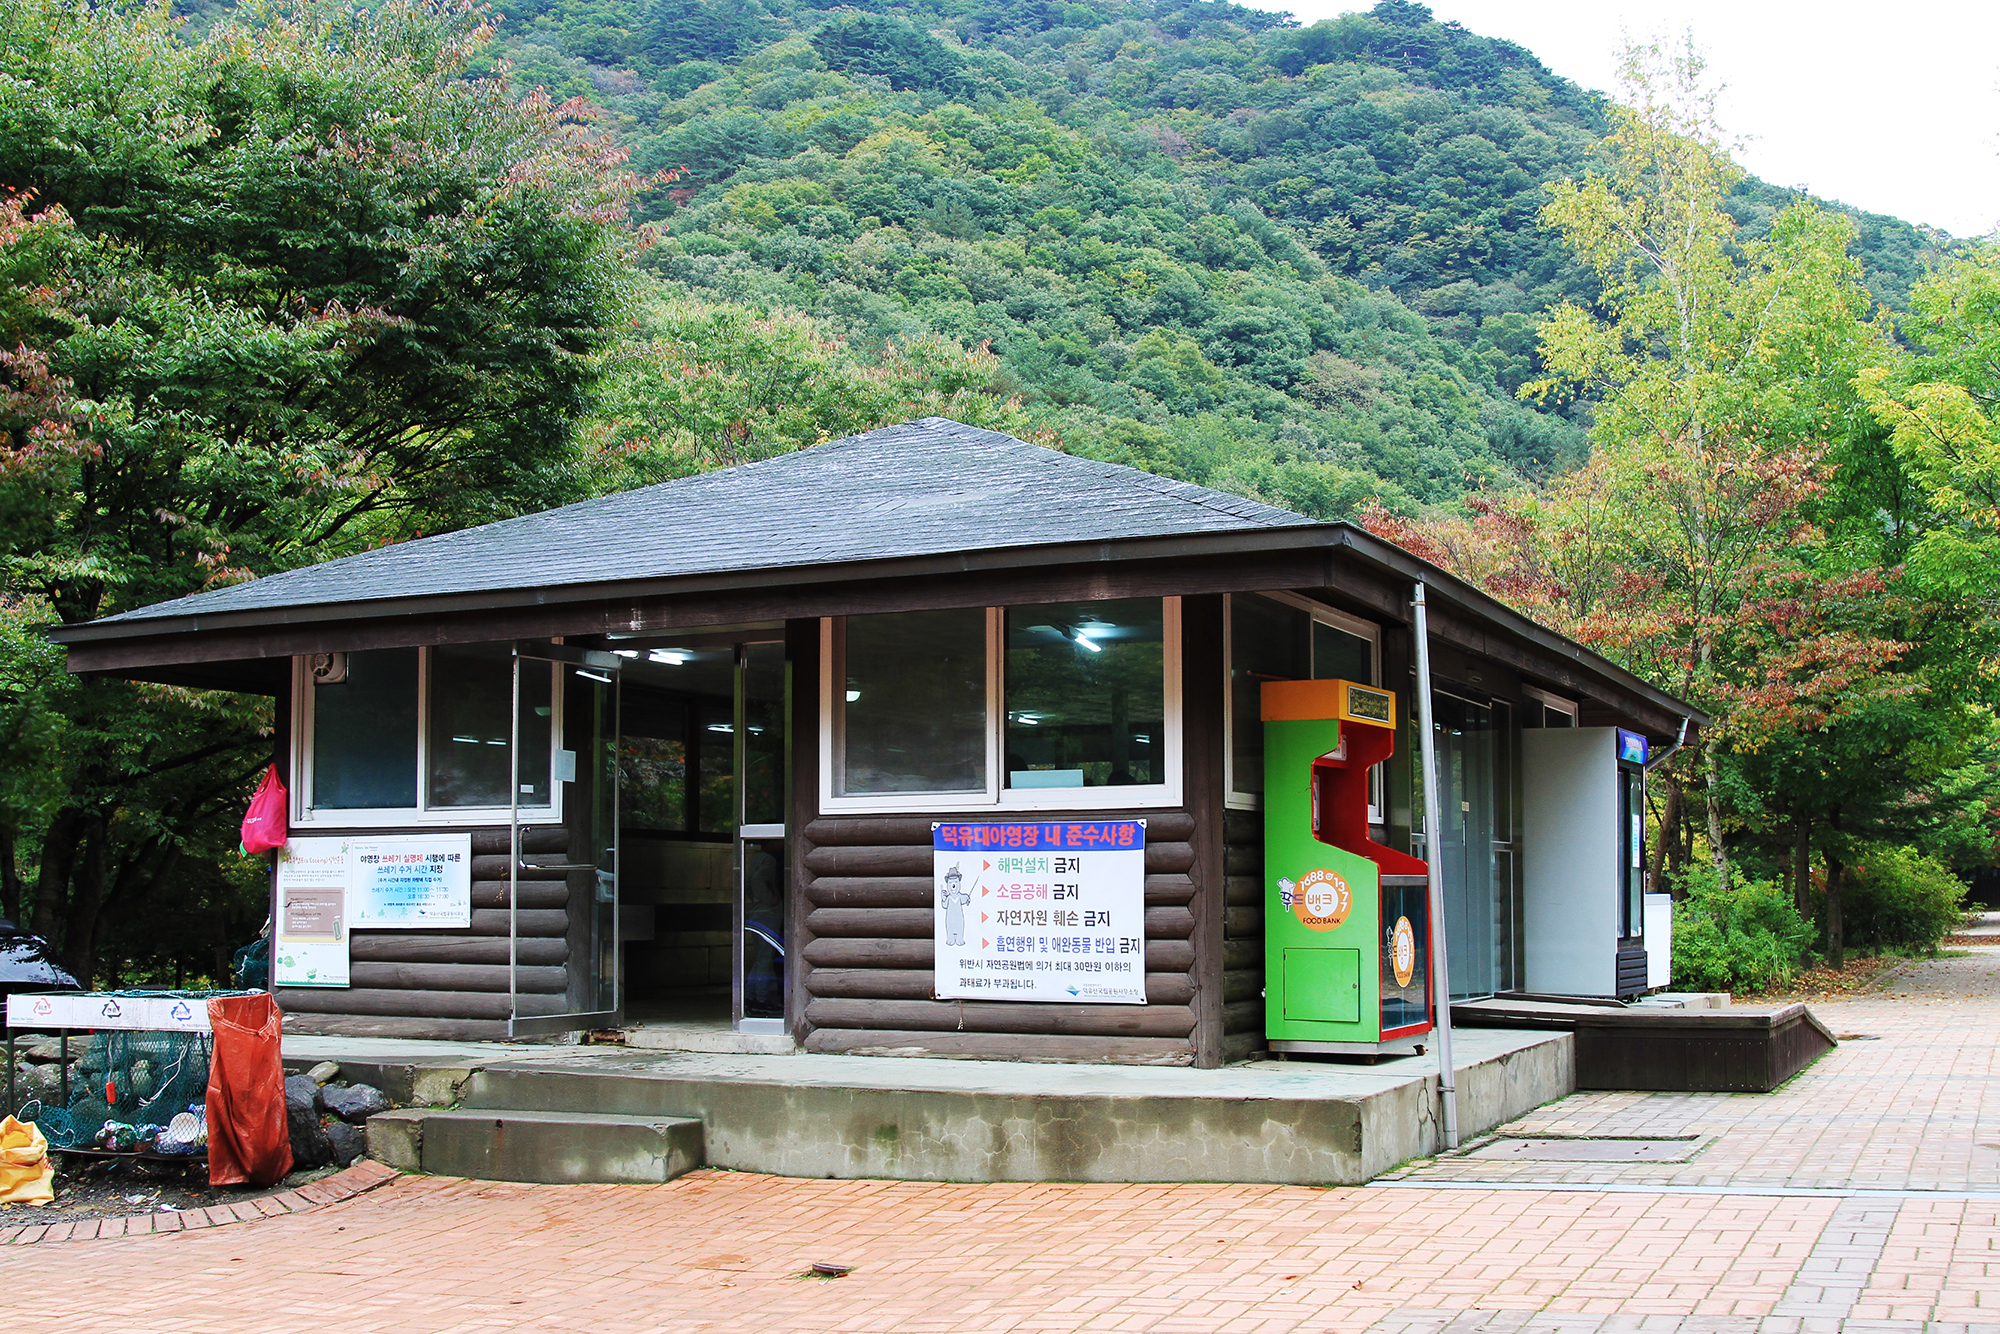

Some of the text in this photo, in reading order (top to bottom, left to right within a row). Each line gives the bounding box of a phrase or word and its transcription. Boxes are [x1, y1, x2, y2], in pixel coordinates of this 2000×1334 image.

[942, 824, 1135, 846] 덕유대야영장 내 준수사항
[360, 853, 461, 864] 야영장 쓰레기 실명제 시행에 따른
[998, 857, 1080, 873] 해먹설치 금지
[377, 864, 443, 874] 쓰레기 수거 시간 지정
[997, 883, 1078, 900] 소음공해 금지
[1300, 870, 1349, 912] 1688 1377
[997, 910, 1110, 927] 자연자원 훼손 금지
[997, 936, 1140, 954] 흡연행위 및 애완동물 반입 금지
[959, 959, 1132, 973] 위반시 자연공원법에 의거 최대 30만원 이하의
[959, 978, 1037, 989] 과태료가 부과됩니다.
